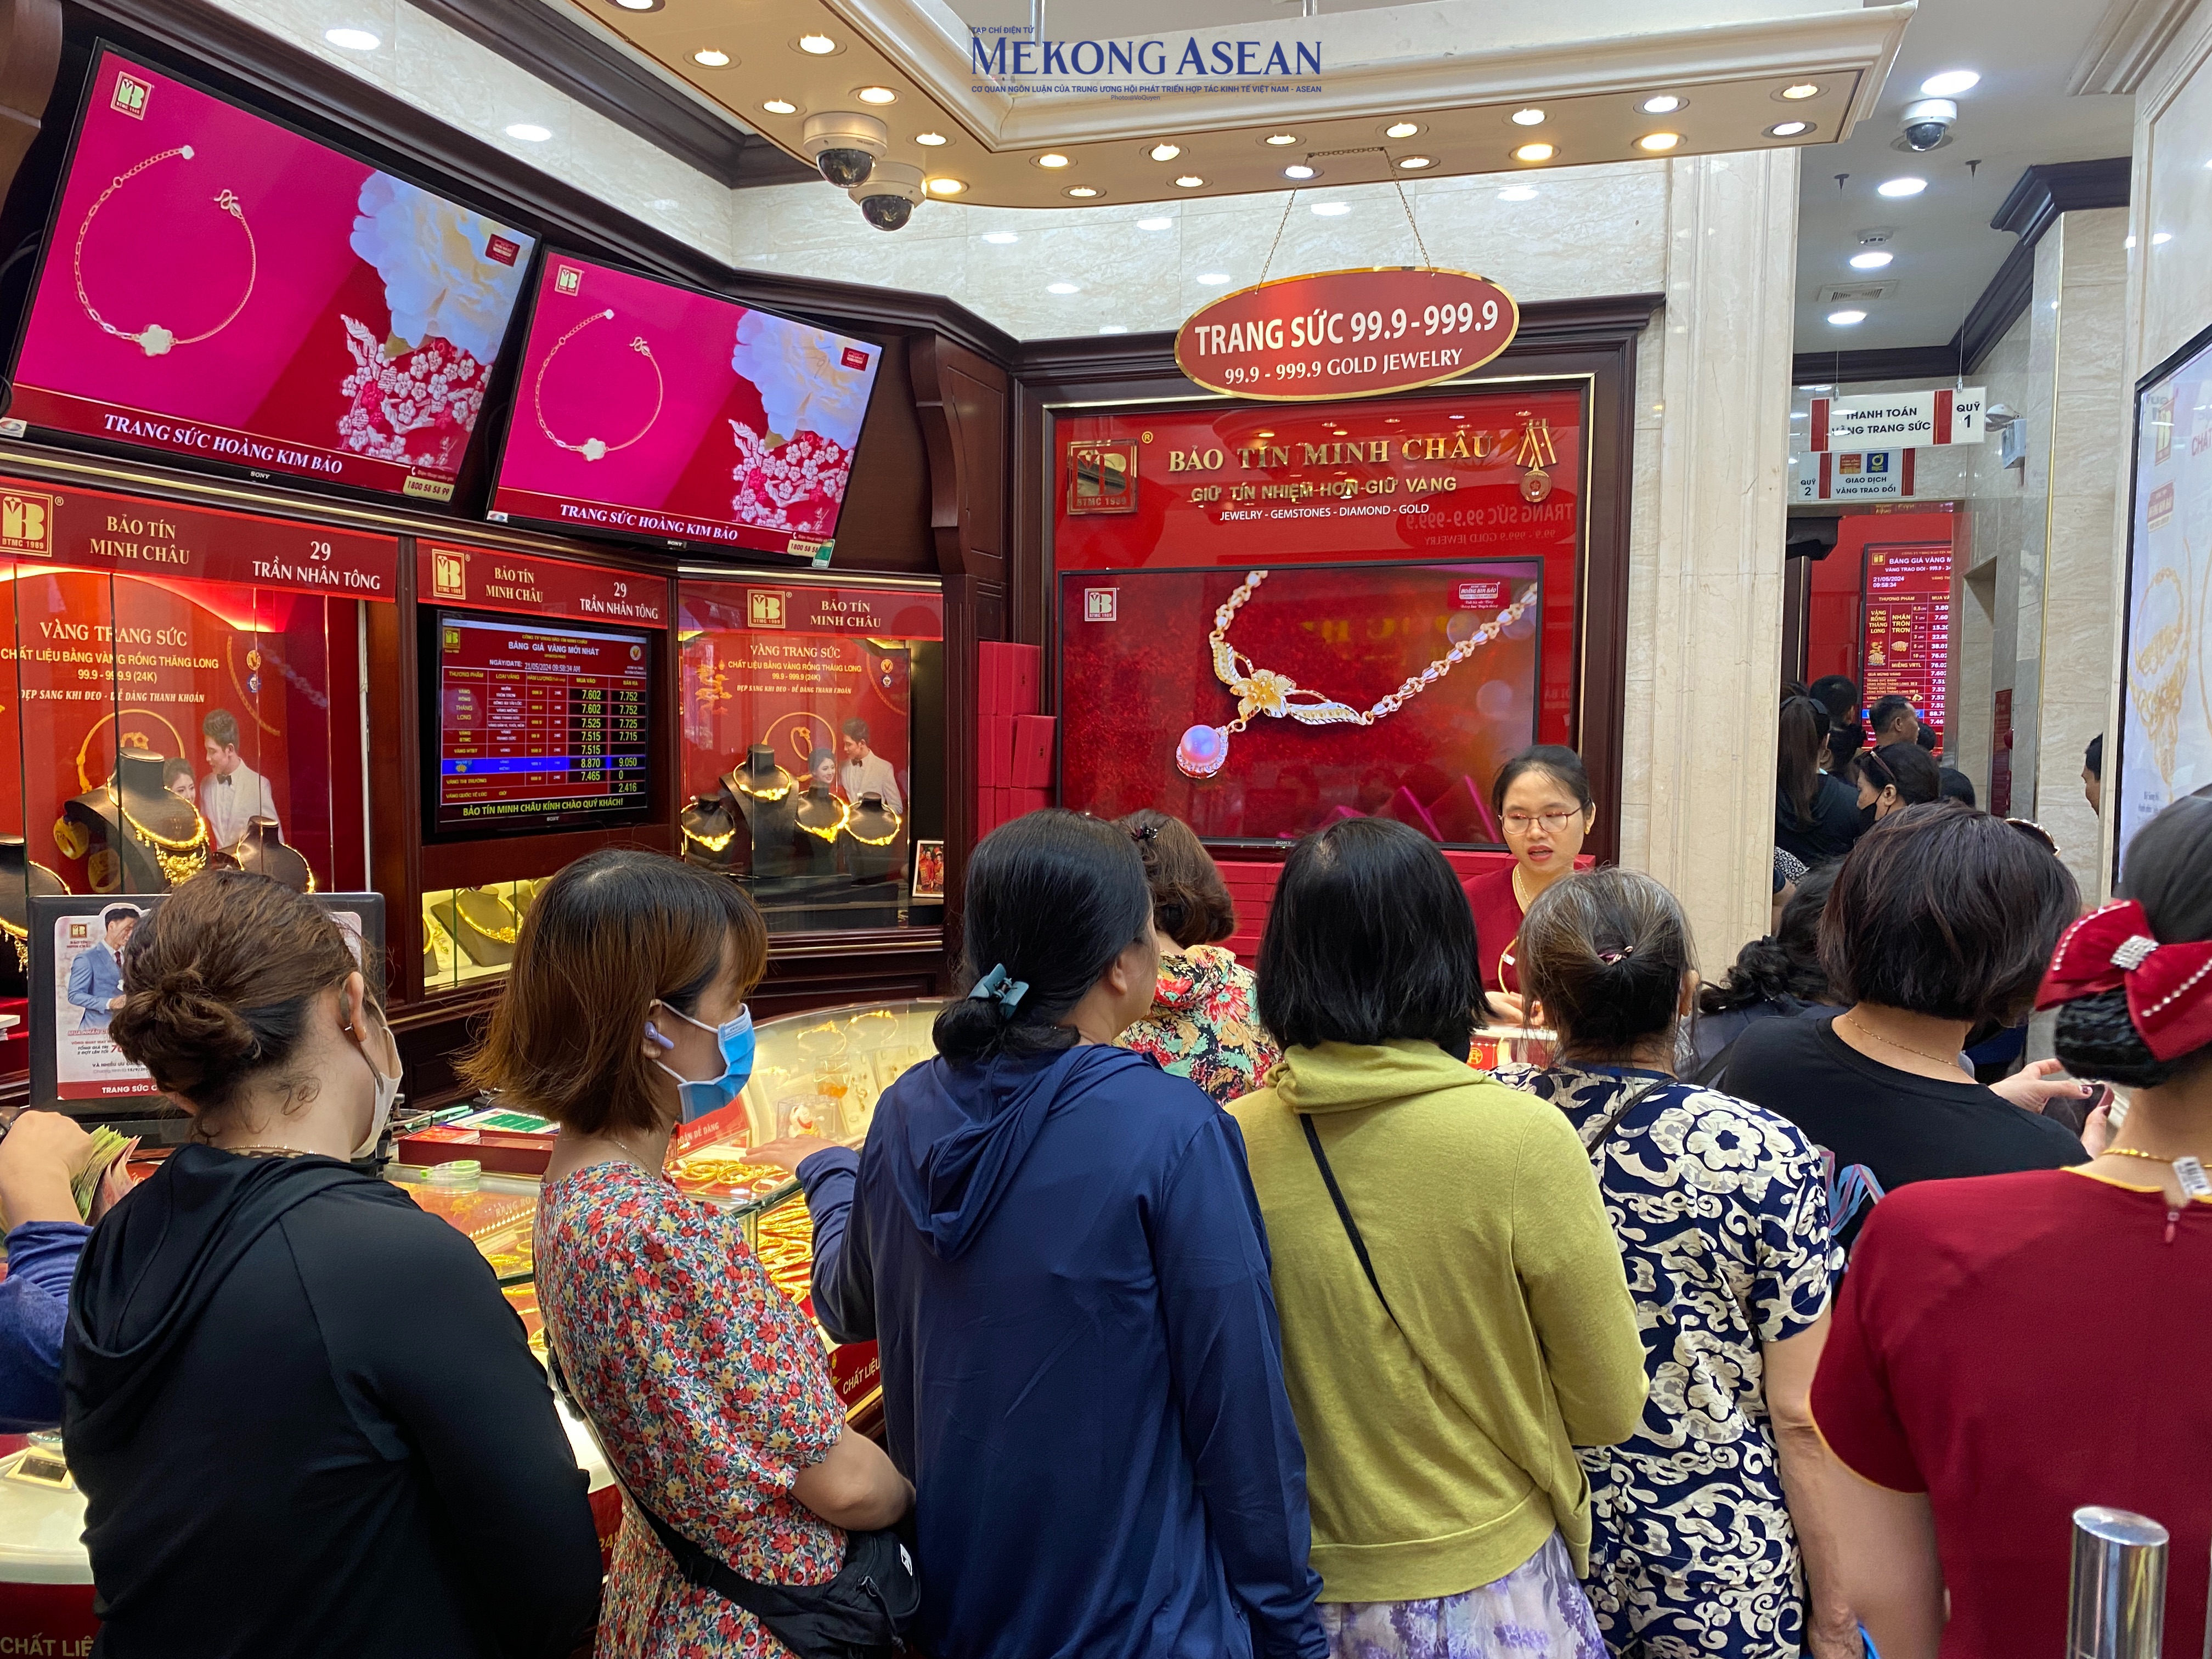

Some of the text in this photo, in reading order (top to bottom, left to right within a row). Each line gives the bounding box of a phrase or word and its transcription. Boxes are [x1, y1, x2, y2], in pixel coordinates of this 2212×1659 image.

[1194, 308, 1344, 356] TRANG SỨC
[1224, 348, 1463, 385] 99.9 999.9 GOLD JEWELRY
[1886, 406, 1917, 418] TOÁN
[1956, 401, 1980, 413] QUỸ
[1867, 420, 1931, 434] TRANG SỨC
[1963, 414, 1971, 428] 1
[104, 414, 343, 474] TRANG SỨC HOÀNG KIM BẢO
[1169, 430, 1493, 473] BẢO TÍN MINH CHÂU
[250, 471, 270, 480] SONY
[1867, 476, 1887, 484] DỊCH
[407, 481, 422, 490] 1800
[1191, 484, 1223, 503] GIỮ
[1229, 482, 1257, 501] TÍN
[1320, 479, 1359, 497] HƠN
[1365, 476, 1399, 494] GIỮ
[1406, 475, 1457, 493] VÀNG
[1804, 487, 1811, 496] 2
[1836, 485, 1861, 494] VÀNG
[1076, 496, 1102, 507] BTMC
[1220, 504, 1430, 522] JEWELRY GEMSTONES DIAMOND GOLD
[107, 514, 176, 539] BẢO TÍN
[560, 504, 738, 540] TRANG SỨC HOÀNG KIM BẢO
[2, 538, 44, 550] BTMC 1989
[89, 538, 190, 565] MINH CHÂU
[310, 540, 331, 561] 29
[252, 555, 381, 590] TRẦN NHÂN TÔNG
[495, 565, 534, 584] BẢO TÍN
[486, 584, 543, 603] MINH CHÂU
[613, 582, 627, 598] 29
[579, 593, 658, 620] TRẦN NHÂN TÔNG
[821, 598, 871, 612] BẢO TÍN
[810, 614, 881, 628] MINH CHÂU
[40, 618, 188, 647] VÀNG SỨC
[548, 643, 566, 653] VÀNG
[750, 643, 840, 658] VÀNG TRANG SỨC
[36, 649, 60, 664] LIỆU
[159, 653, 191, 668] THĂNG
[193, 658, 219, 669] LONG
[525, 662, 551, 671] 21/05/2024
[78, 669, 157, 684] 99.9 (24K)
[805, 674, 821, 682] (24K)
[39, 690, 176, 702] SANG KHI THANH
[582, 690, 601, 700] 7.602
[620, 691, 637, 701] 7.752
[582, 703, 601, 714] 7.602
[619, 704, 637, 715] 7.752
[582, 718, 601, 729] 7.525
[619, 719, 637, 729] 7.725
[582, 731, 601, 741] 7.515
[619, 731, 637, 741] 7.715
[582, 744, 601, 755] 7.515
[581, 758, 600, 768] 8.870
[619, 758, 637, 767] 9.050
[581, 771, 600, 781] 7.465
[619, 770, 623, 780] 0
[619, 782, 637, 793] 2.416
[463, 797, 623, 816] BẢO TÍN MINH CHÂU KÍNH CHÀO QUÝ KHÁCH!
[101, 1084, 149, 1094] TRANG SỨC
[843, 1367, 864, 1395] CHẤT
[0, 1632, 57, 1657] CHẤT
